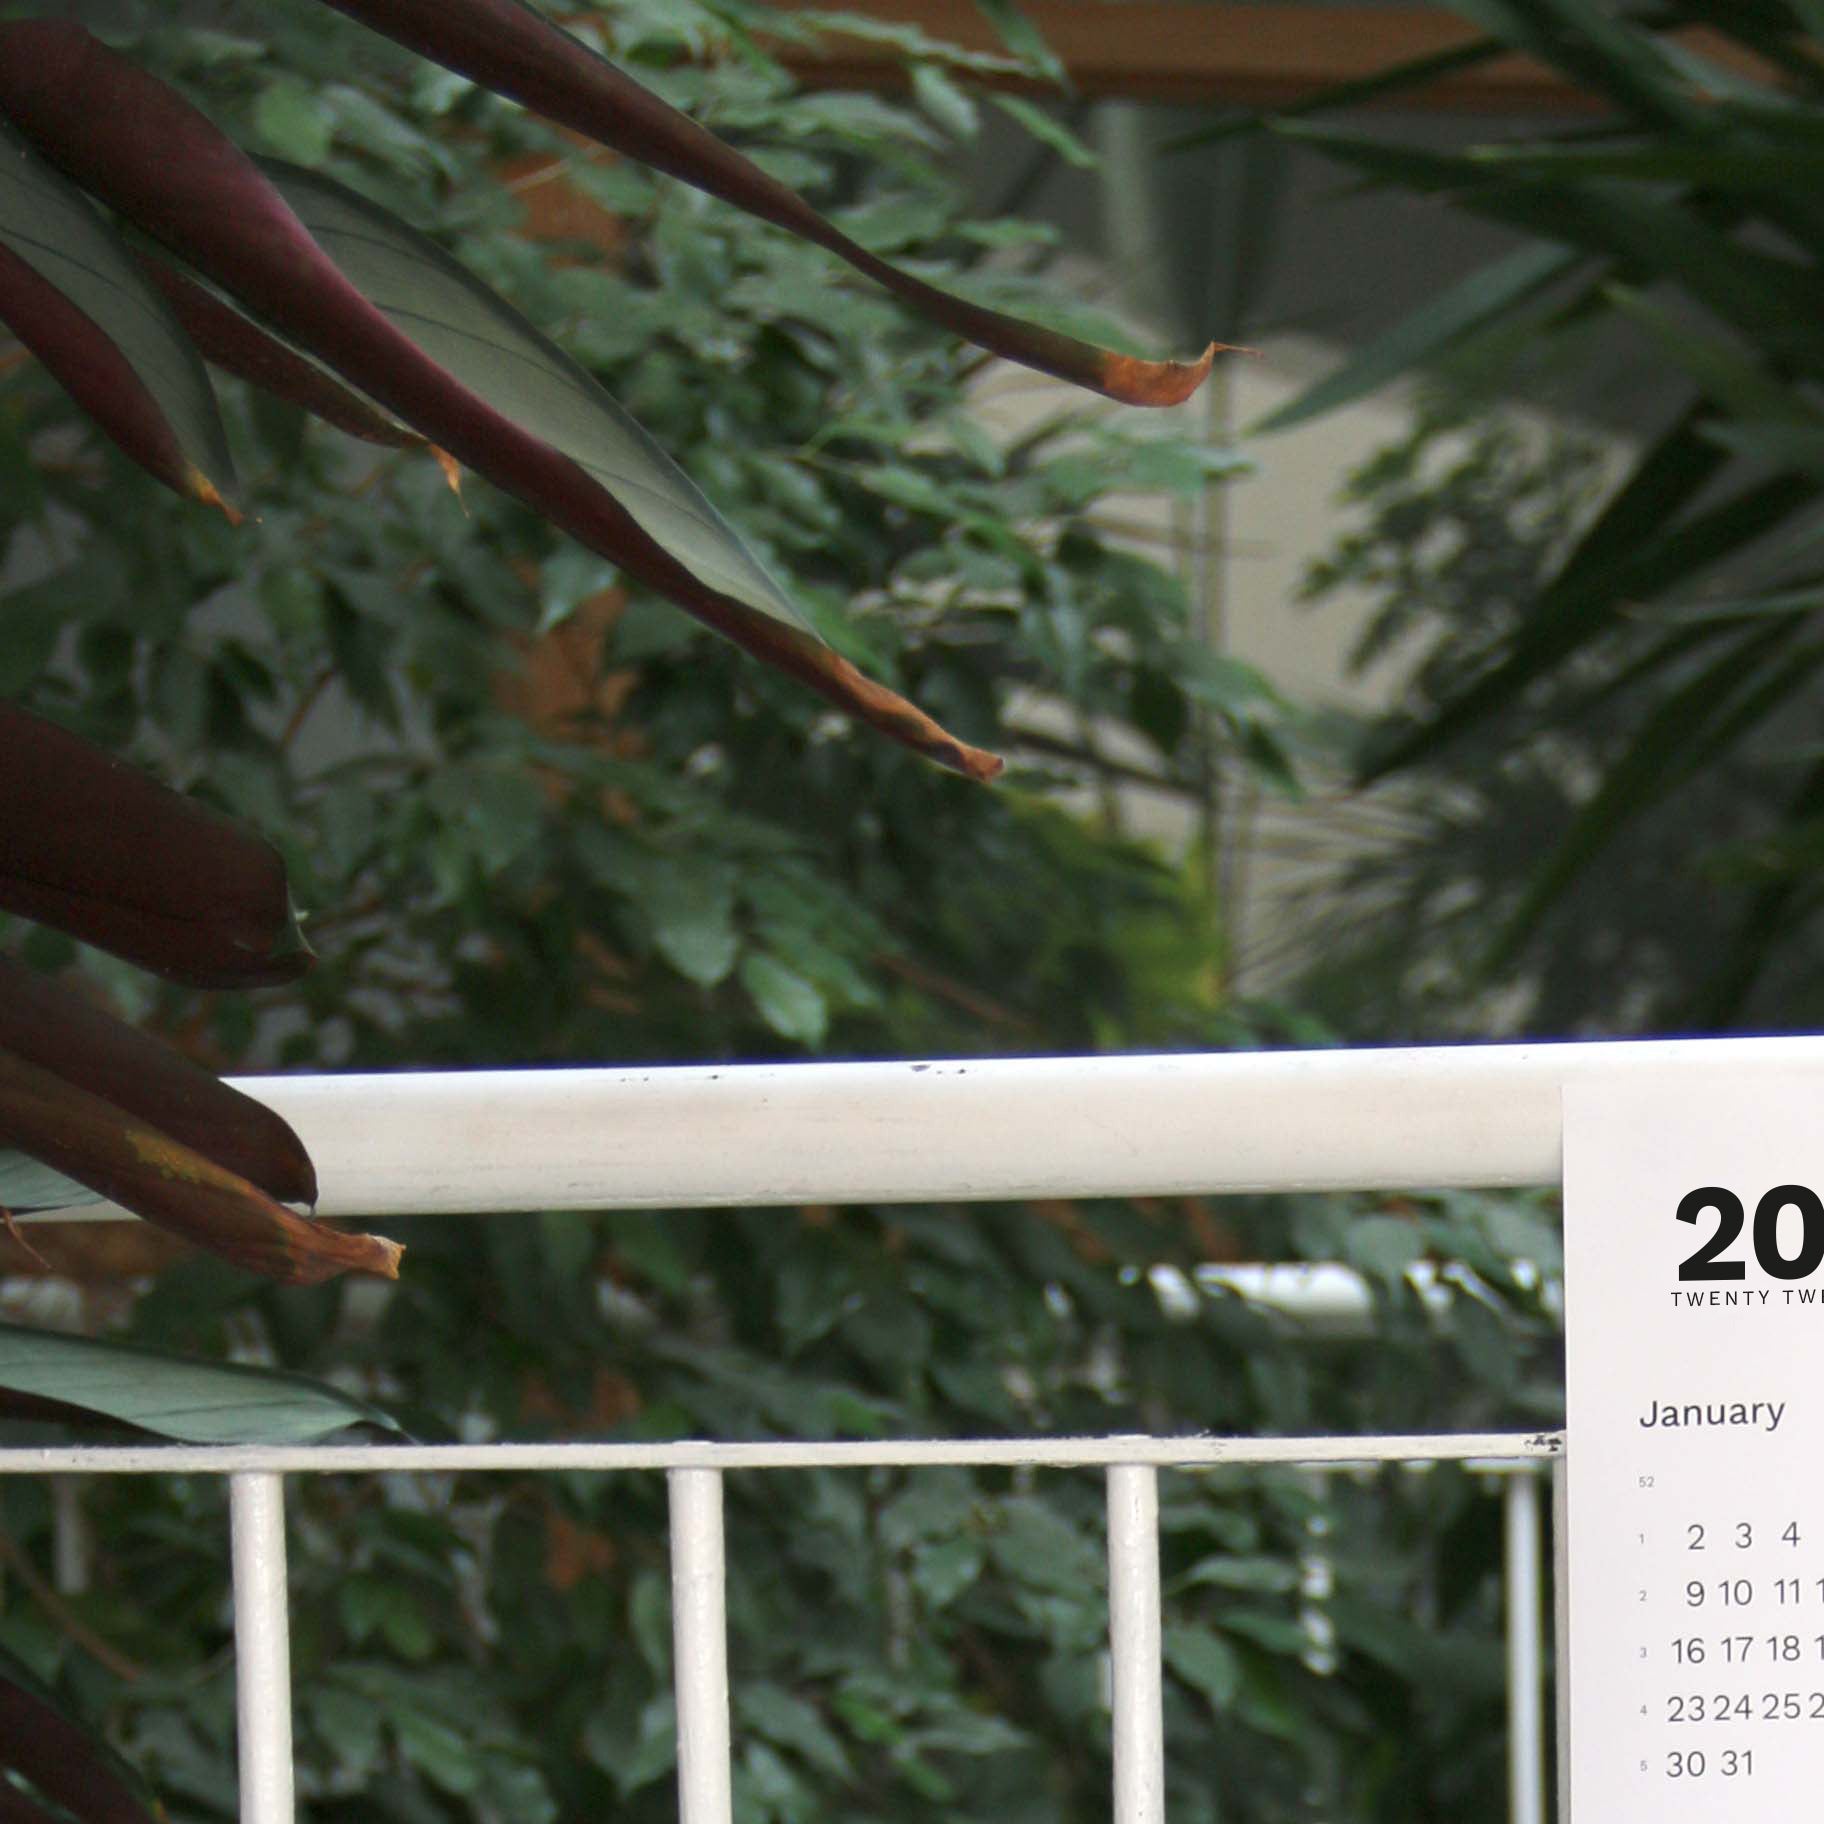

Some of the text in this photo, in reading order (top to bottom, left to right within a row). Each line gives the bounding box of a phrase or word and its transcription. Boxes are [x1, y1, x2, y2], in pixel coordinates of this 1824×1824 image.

[1671, 1290, 1769, 1306] TWENTY
[1640, 1401, 1784, 1431] January
[1688, 1524, 1704, 1550] 2
[1736, 1523, 1752, 1549] 3
[1782, 1521, 1801, 1547] 4
[1687, 1581, 1705, 1607] 9
[1719, 1580, 1752, 1605] 10
[1774, 1579, 1799, 1604] 11
[1667, 1751, 1705, 1777] 30
[1721, 1750, 1751, 1776] 31
